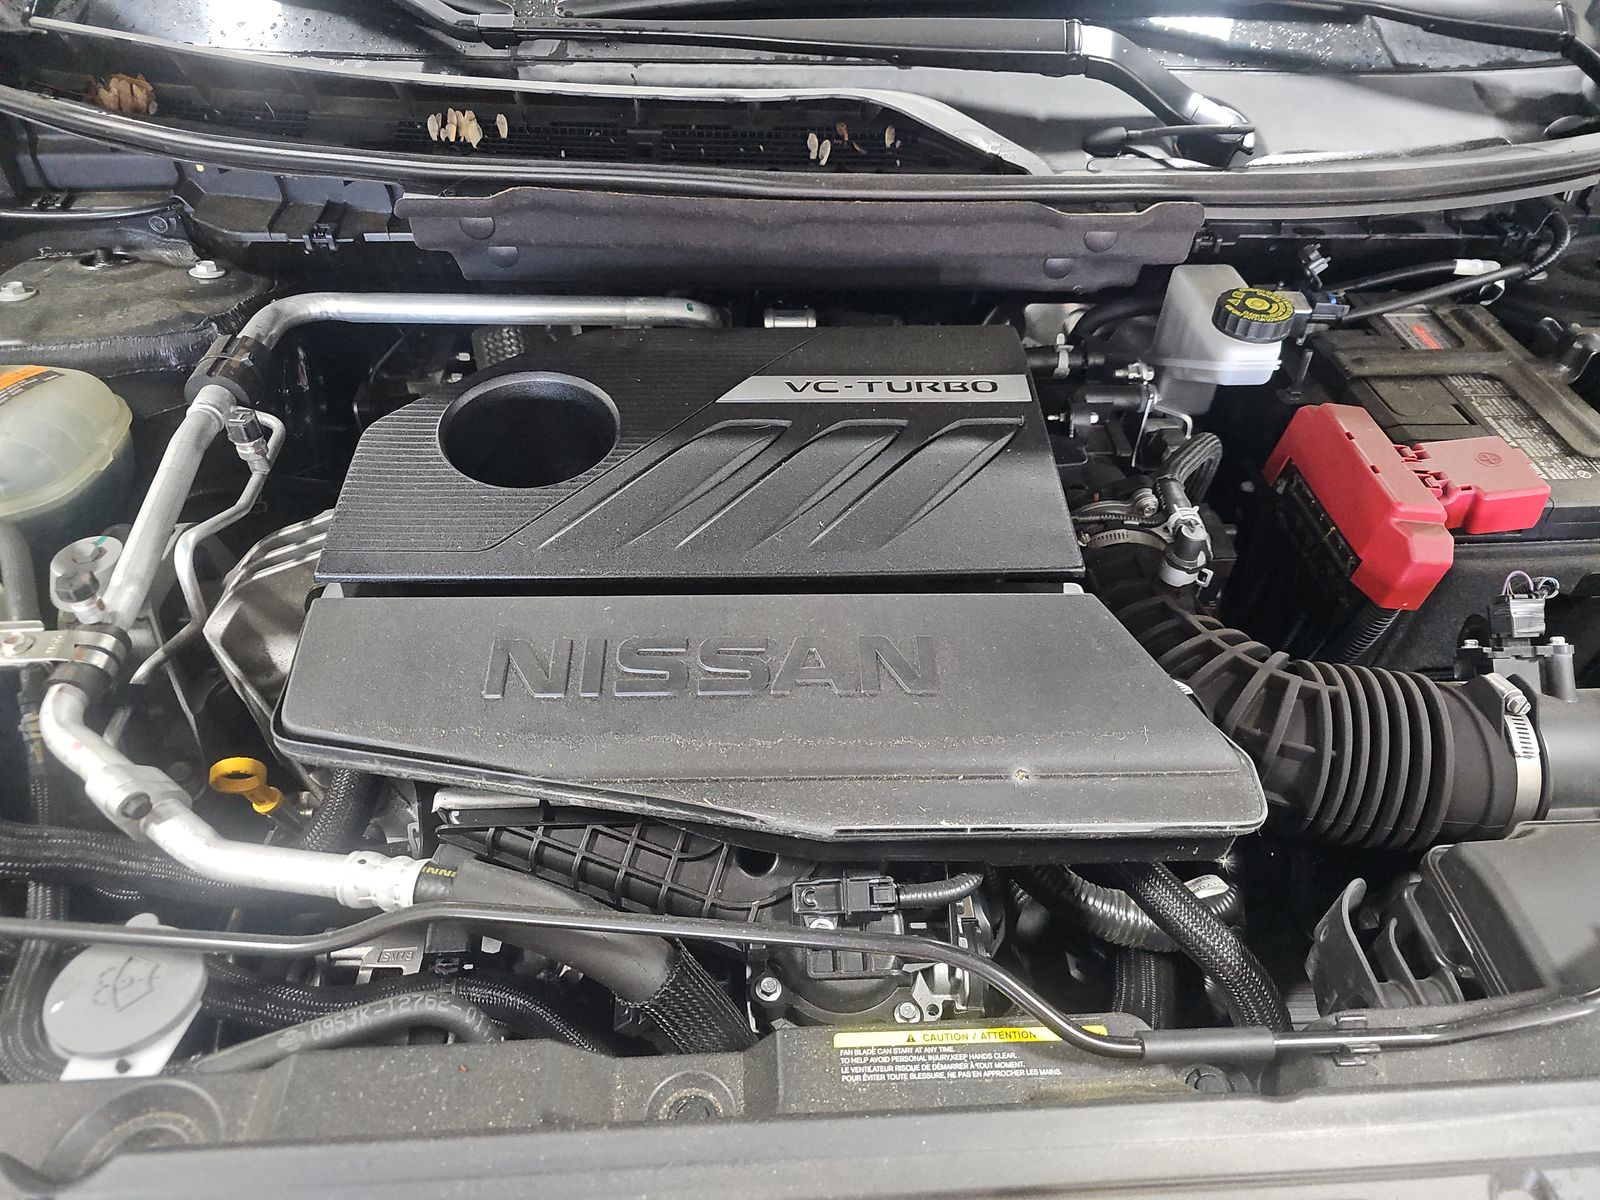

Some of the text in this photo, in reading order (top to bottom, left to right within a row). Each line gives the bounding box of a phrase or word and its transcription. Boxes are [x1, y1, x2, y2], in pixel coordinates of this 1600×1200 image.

[784, 380, 998, 393] VC-TURBO
[483, 635, 938, 699] NISSAN
[922, 1033, 969, 1042] CAUTION
[980, 1031, 1037, 1040] ATTENTION
[850, 1065, 894, 1073] VENTILATEUR
[862, 1073, 885, 1081] ÉVITER
[983, 1069, 1025, 1077] APPROCHER
